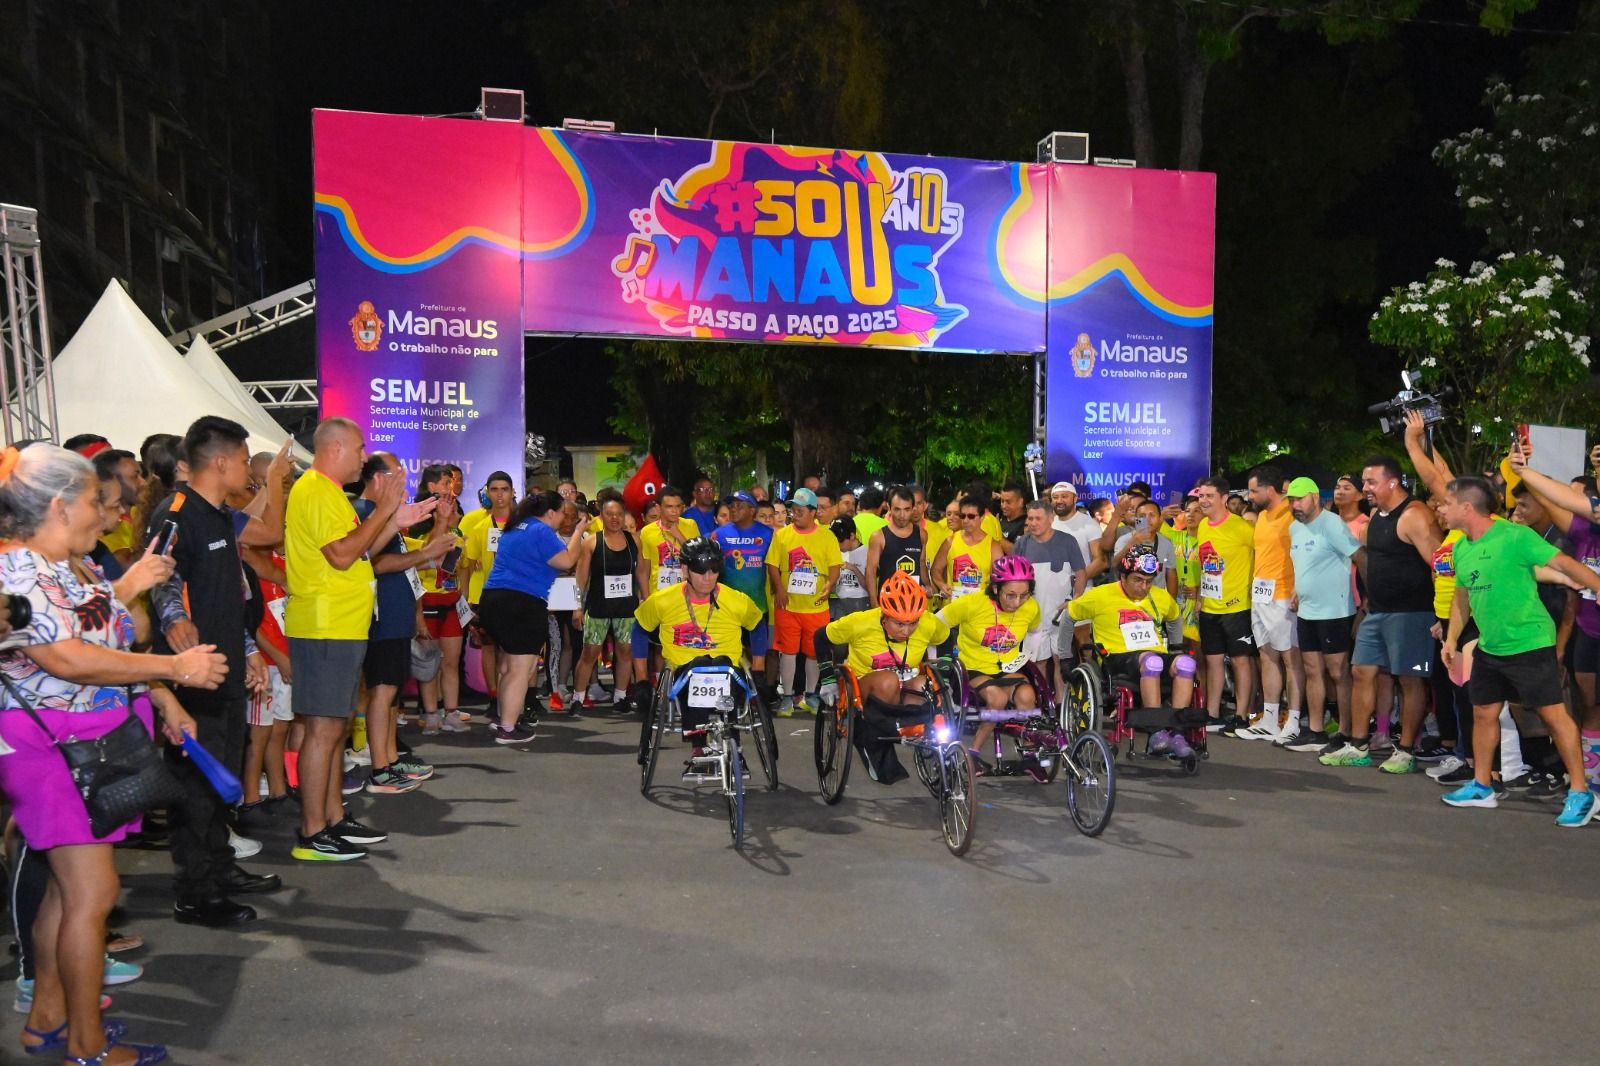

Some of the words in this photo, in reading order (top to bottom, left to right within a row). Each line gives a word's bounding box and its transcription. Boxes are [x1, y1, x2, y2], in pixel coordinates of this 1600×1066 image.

[644, 234, 938, 306] MANAUS
[420, 303, 456, 312] Prefeitura
[388, 309, 498, 339] Manaus
[688, 304, 757, 331] PASSO
[764, 313, 780, 334] A
[787, 314, 839, 337] PAÇO
[848, 309, 898, 333] 2025
[1126, 333, 1155, 341] Prefeitura
[388, 342, 399, 352] O
[401, 343, 448, 354] trabalho
[451, 344, 472, 356] não
[473, 347, 498, 358] para
[1101, 339, 1188, 364] Manaus
[1101, 368, 1108, 377] O
[1110, 369, 1148, 379] trabalho
[1150, 369, 1166, 379] não
[1168, 372, 1188, 381] para
[370, 377, 473, 406] SEMJEL
[370, 405, 418, 416] Secretaria
[420, 407, 464, 419] Municipal
[467, 408, 479, 418] de
[1084, 401, 1167, 424] SEMJEL
[370, 419, 419, 430] Juventude
[422, 421, 458, 433] Esporte
[461, 423, 467, 431] e
[1084, 425, 1122, 435] Secretaria
[1124, 426, 1160, 436] Municipal
[1161, 427, 1171, 435] de
[370, 432, 395, 443] Lazer
[1084, 438, 1123, 447] Juventude
[1125, 439, 1155, 449] Esporte
[1083, 450, 1104, 459] Lazer
[1155, 491, 1166, 500] de
[610, 582, 626, 591] 516
[791, 578, 814, 588] 2977
[1254, 586, 1272, 597] 2970
[1130, 630, 1151, 641] 974
[692, 686, 725, 697] 2981
